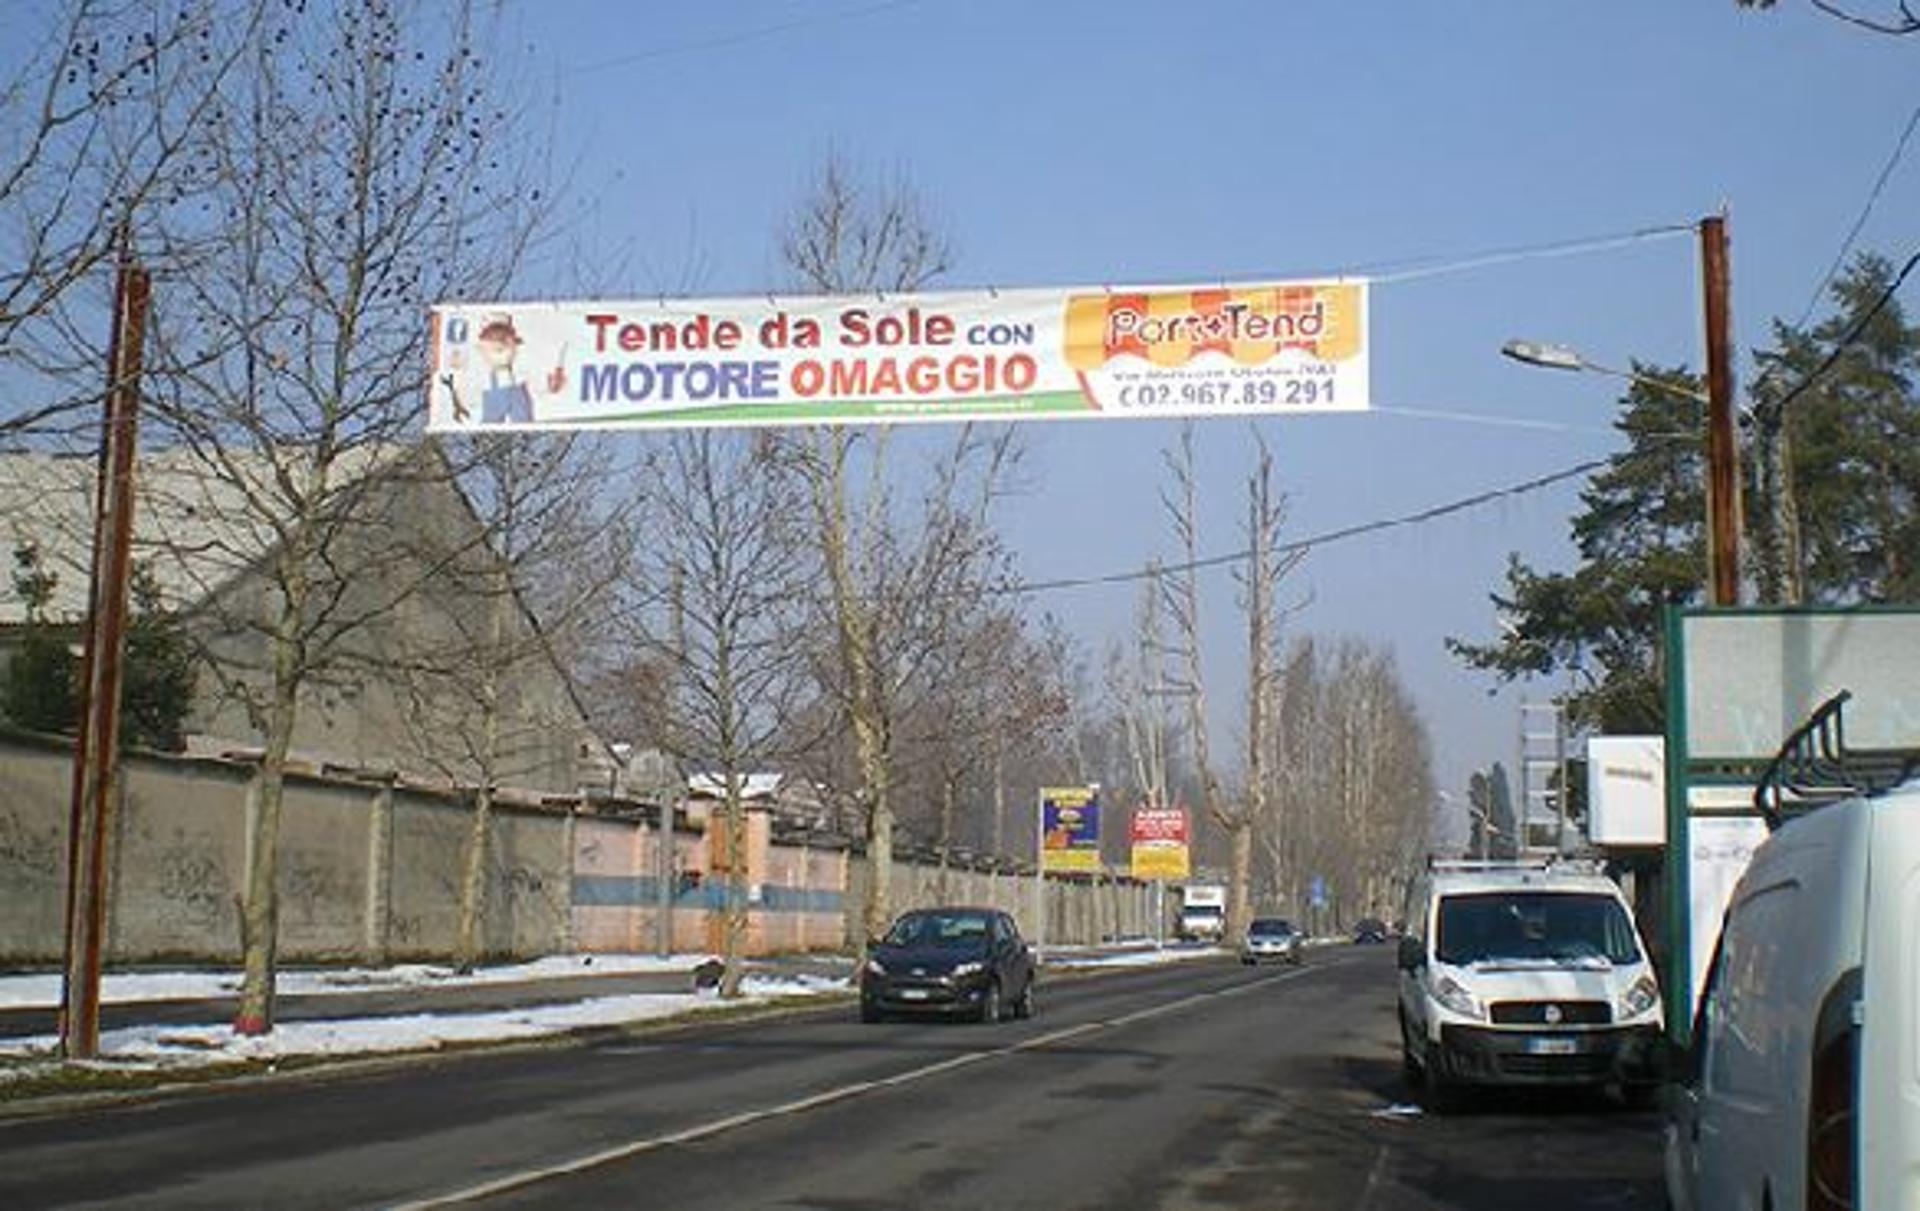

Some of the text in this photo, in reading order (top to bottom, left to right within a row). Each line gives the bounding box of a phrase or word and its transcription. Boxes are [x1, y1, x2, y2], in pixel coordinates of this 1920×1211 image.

[585, 307, 1035, 352] Tende da Sole CON
[580, 353, 1038, 402] MOTORE OMAGGIO
[1285, 377, 1336, 405] 291
